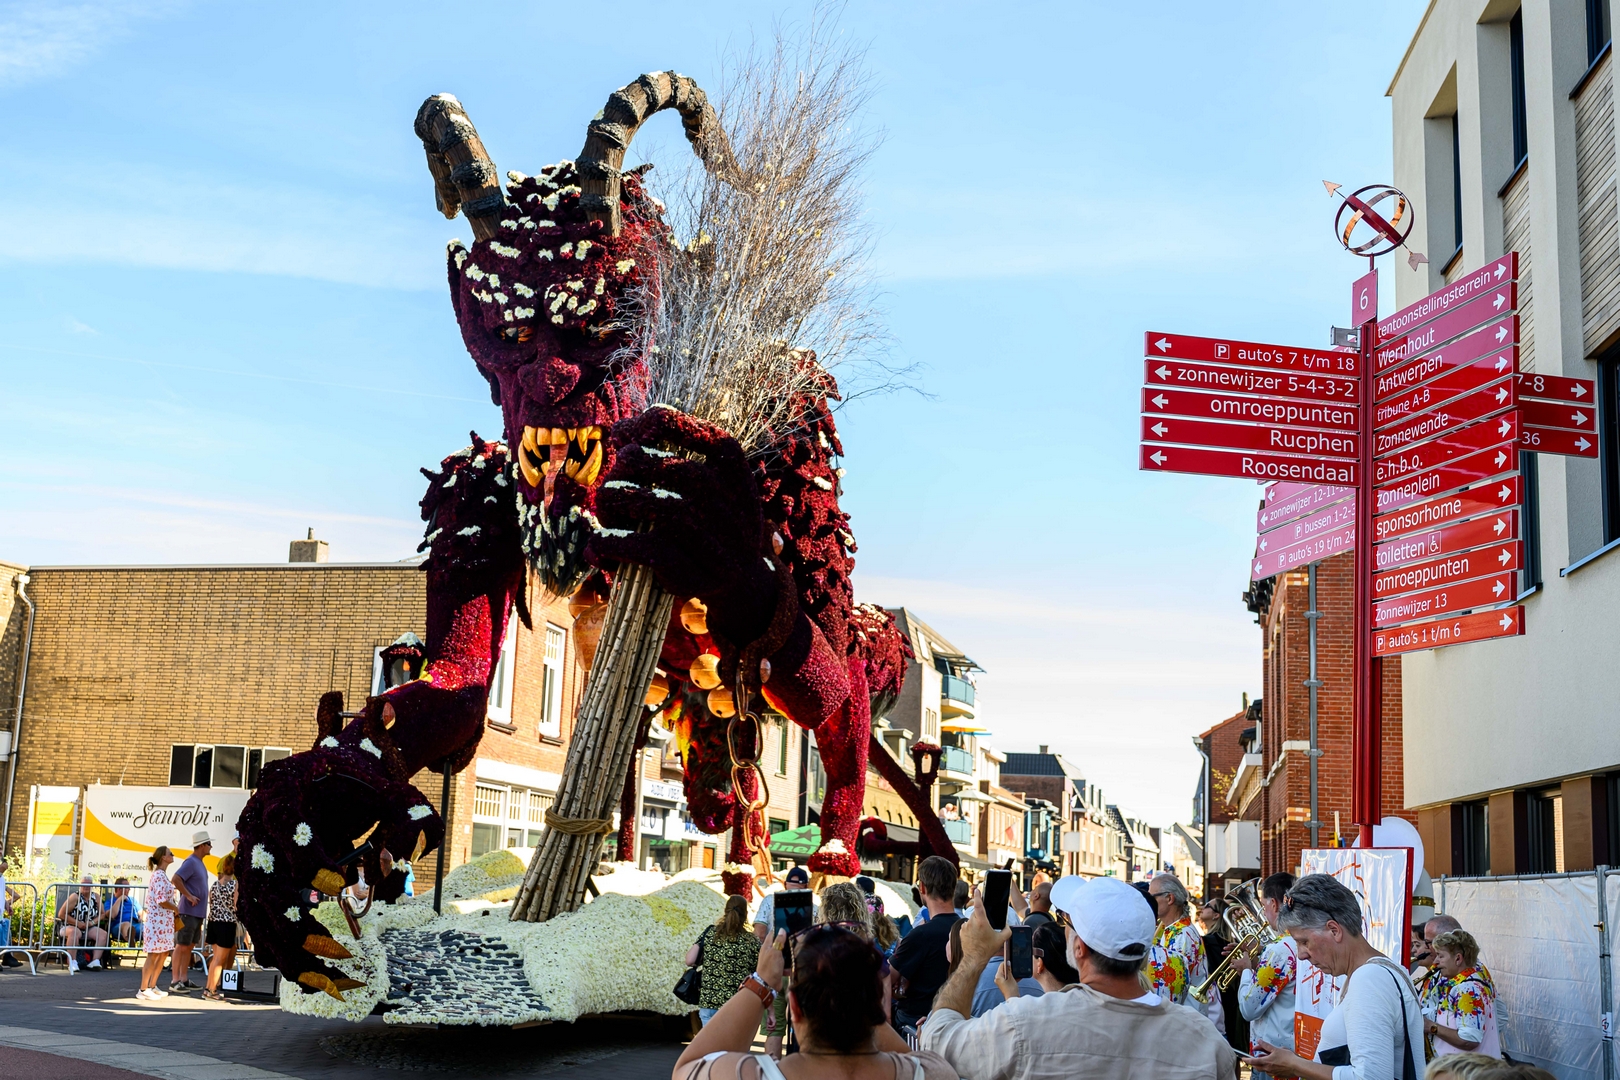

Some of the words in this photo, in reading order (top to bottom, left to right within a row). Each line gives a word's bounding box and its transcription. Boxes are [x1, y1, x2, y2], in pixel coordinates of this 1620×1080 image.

[1360, 288, 1368, 310] 6
[1378, 272, 1491, 338] tentoonstellingsterrein
[1238, 348, 1283, 364] auto's
[1290, 352, 1298, 364] 7
[1303, 354, 1330, 368] t/m
[1337, 358, 1354, 371] 18
[1378, 328, 1435, 368] Wernhout
[1177, 368, 1282, 390] zonnewijzer
[1288, 377, 1354, 397] 5-4-3-2
[1378, 354, 1443, 394] Antwerpen
[1210, 398, 1354, 424] omroeppunten
[1377, 400, 1410, 422] tribune
[1412, 388, 1430, 408] A-B
[1270, 430, 1354, 452] Rucphen
[1378, 412, 1448, 451] Zonnewende
[1522, 432, 1540, 446] 36
[1242, 458, 1354, 482] Roosendaal
[1376, 455, 1423, 481] e.h.b.o.
[1270, 496, 1312, 520] zonnewijzer
[1314, 486, 1348, 503] 12-11-
[1376, 473, 1440, 508] zonneplein
[1304, 515, 1331, 533] bussen
[1376, 499, 1461, 538] sponsorhome
[1288, 545, 1311, 562] auto's
[1314, 540, 1324, 554] 19
[1326, 536, 1342, 551] t/m
[1345, 529, 1355, 544] 24
[1376, 541, 1425, 566] toiletten
[1376, 558, 1469, 592] omroeppunten
[1376, 597, 1431, 621] Zonnewijzer
[1435, 594, 1447, 609] 13
[1389, 630, 1418, 648] auto's
[1431, 626, 1450, 642] t/m
[1454, 623, 1461, 637] 6
[224, 973, 236, 983] 04
